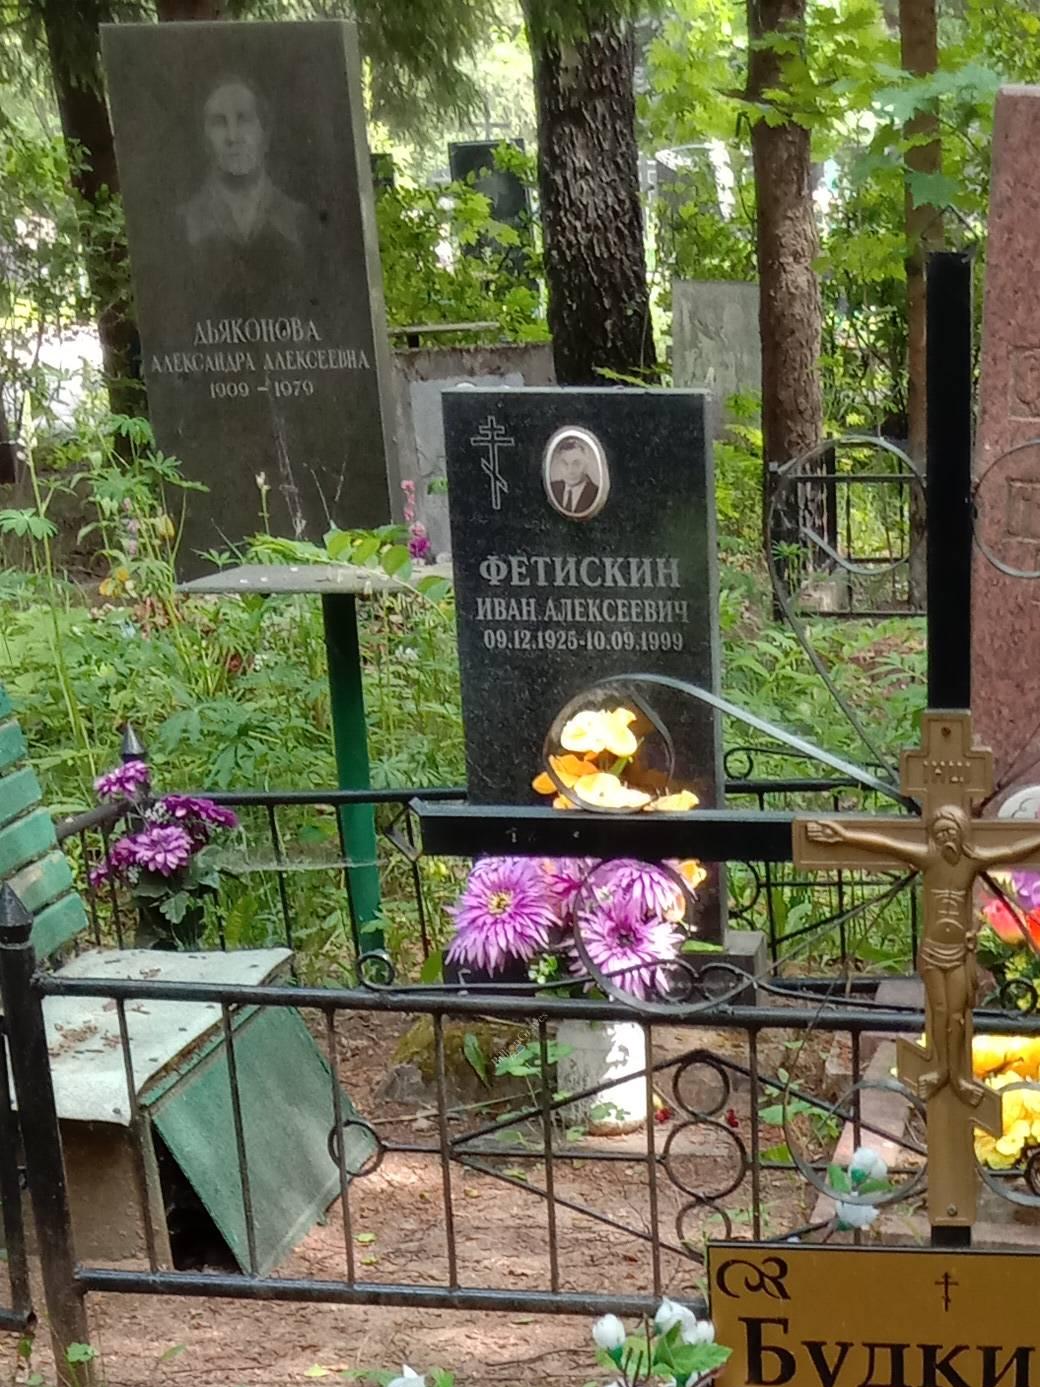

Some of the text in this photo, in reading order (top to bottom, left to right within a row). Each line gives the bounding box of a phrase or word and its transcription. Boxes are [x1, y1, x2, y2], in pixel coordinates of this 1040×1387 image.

[193, 318, 322, 345] ДЬЯКОНОВА
[151, 347, 371, 373] АЛЕКСАНДРА АЛЕКСЕЕВНА
[210, 382, 249, 399] 1909
[275, 381, 314, 397] 1979
[479, 555, 681, 588] ФЕТИСКИН
[475, 598, 689, 623] ИВАН АЛЕКСЕЕВИЧ
